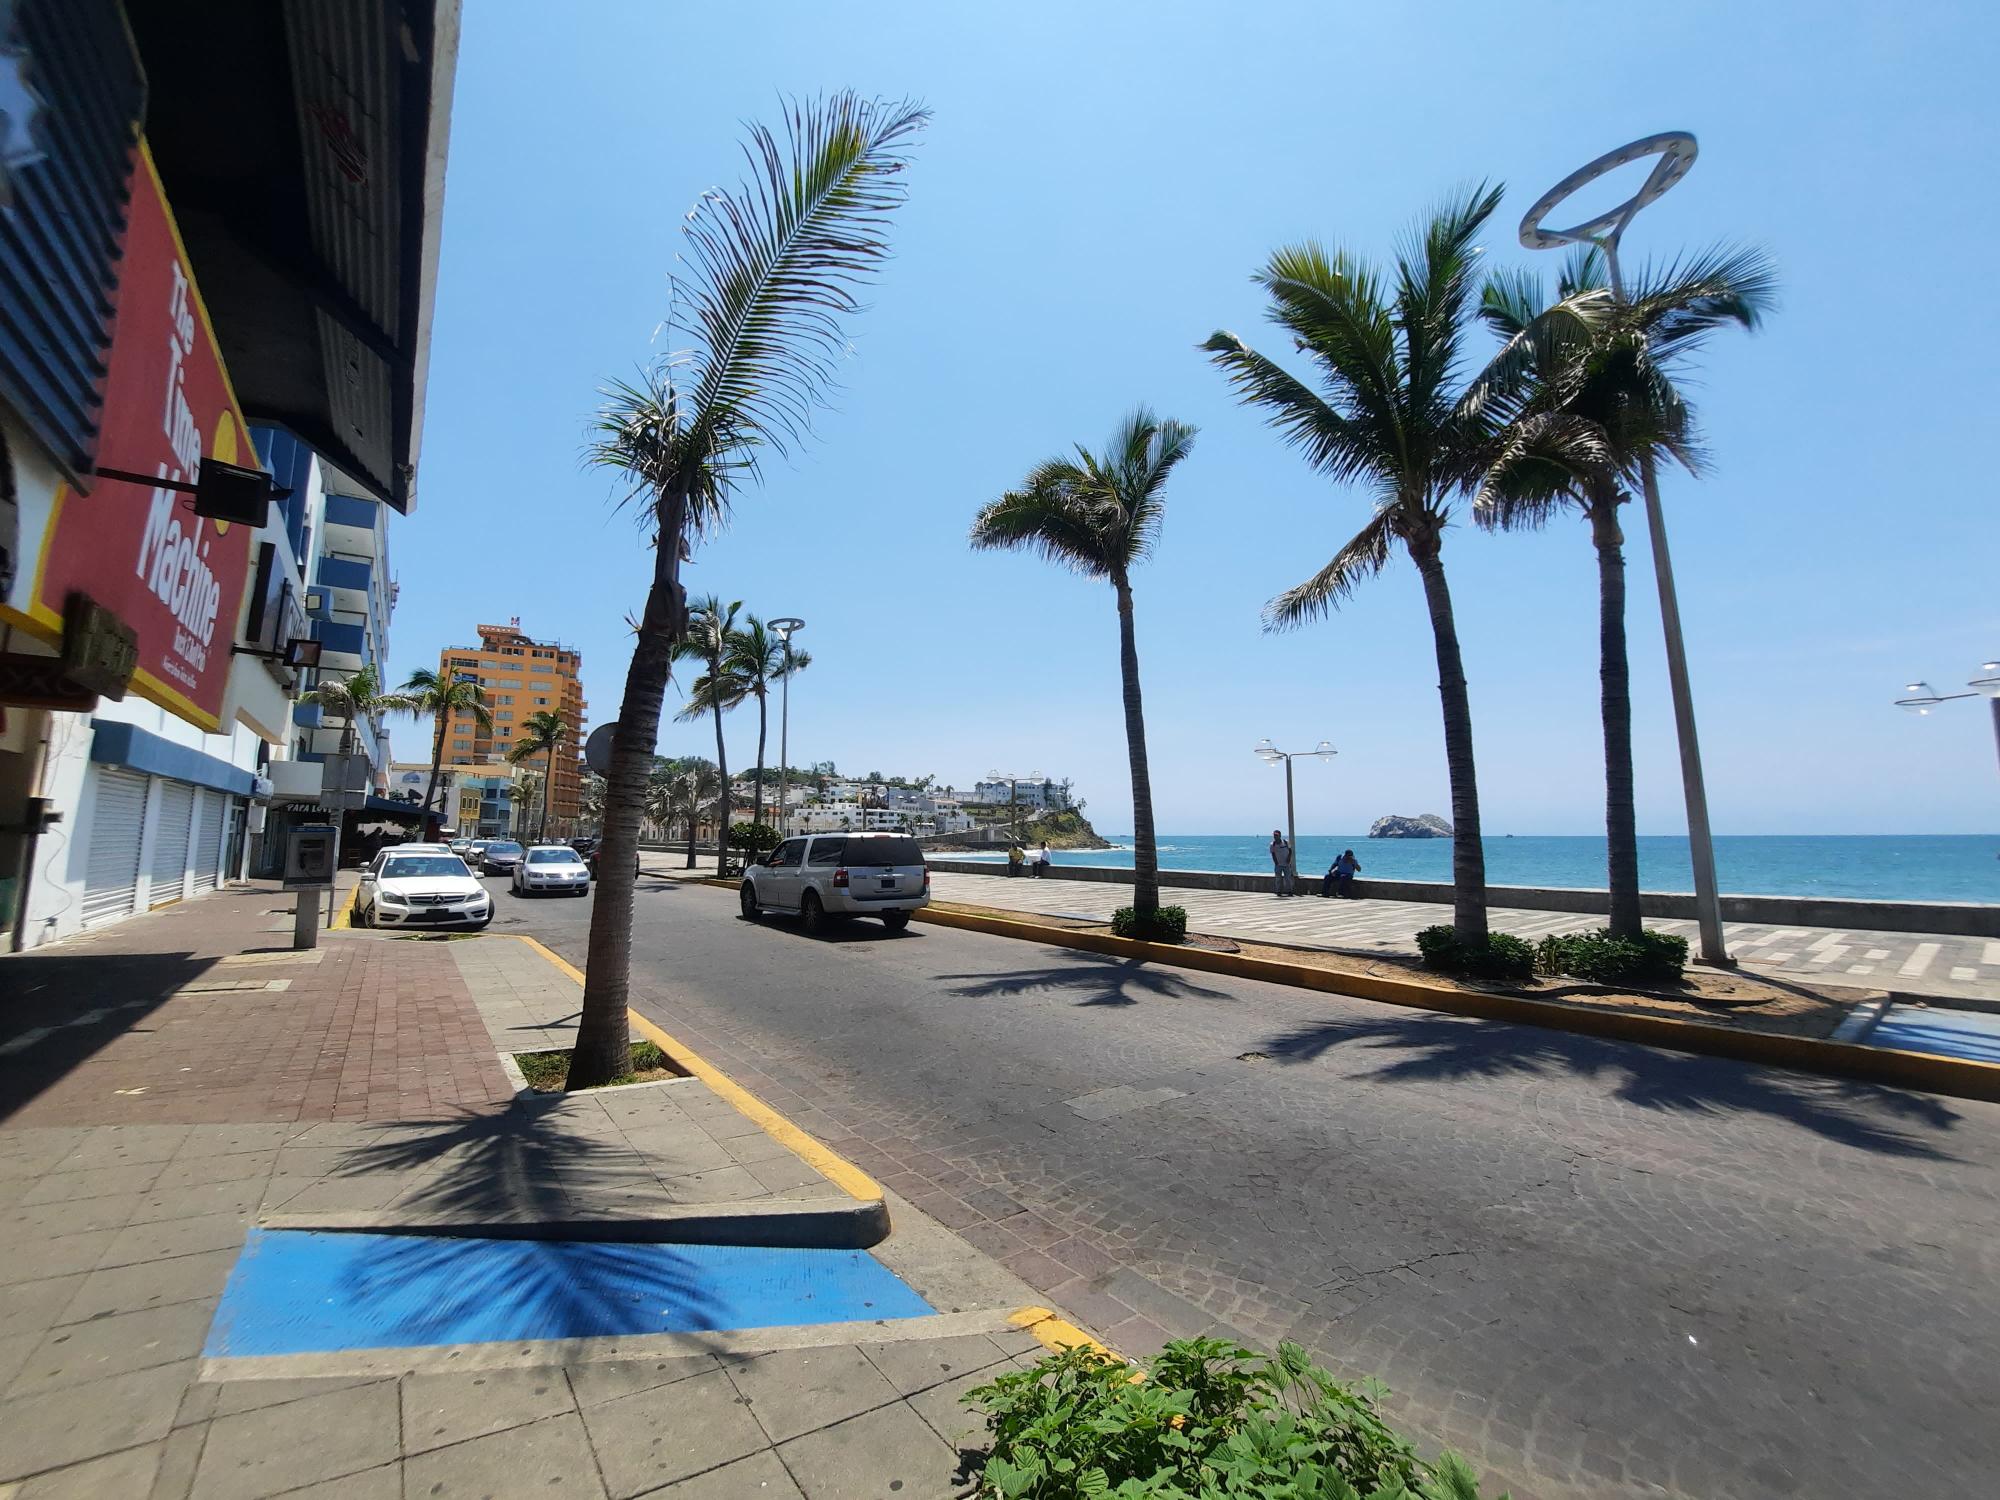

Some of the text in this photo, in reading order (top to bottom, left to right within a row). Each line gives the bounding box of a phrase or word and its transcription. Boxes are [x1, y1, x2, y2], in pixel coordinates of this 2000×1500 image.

[171, 258, 195, 355] The
[164, 333, 202, 486] Time
[136, 461, 220, 648] Machine
[287, 803, 310, 812] PAPA
